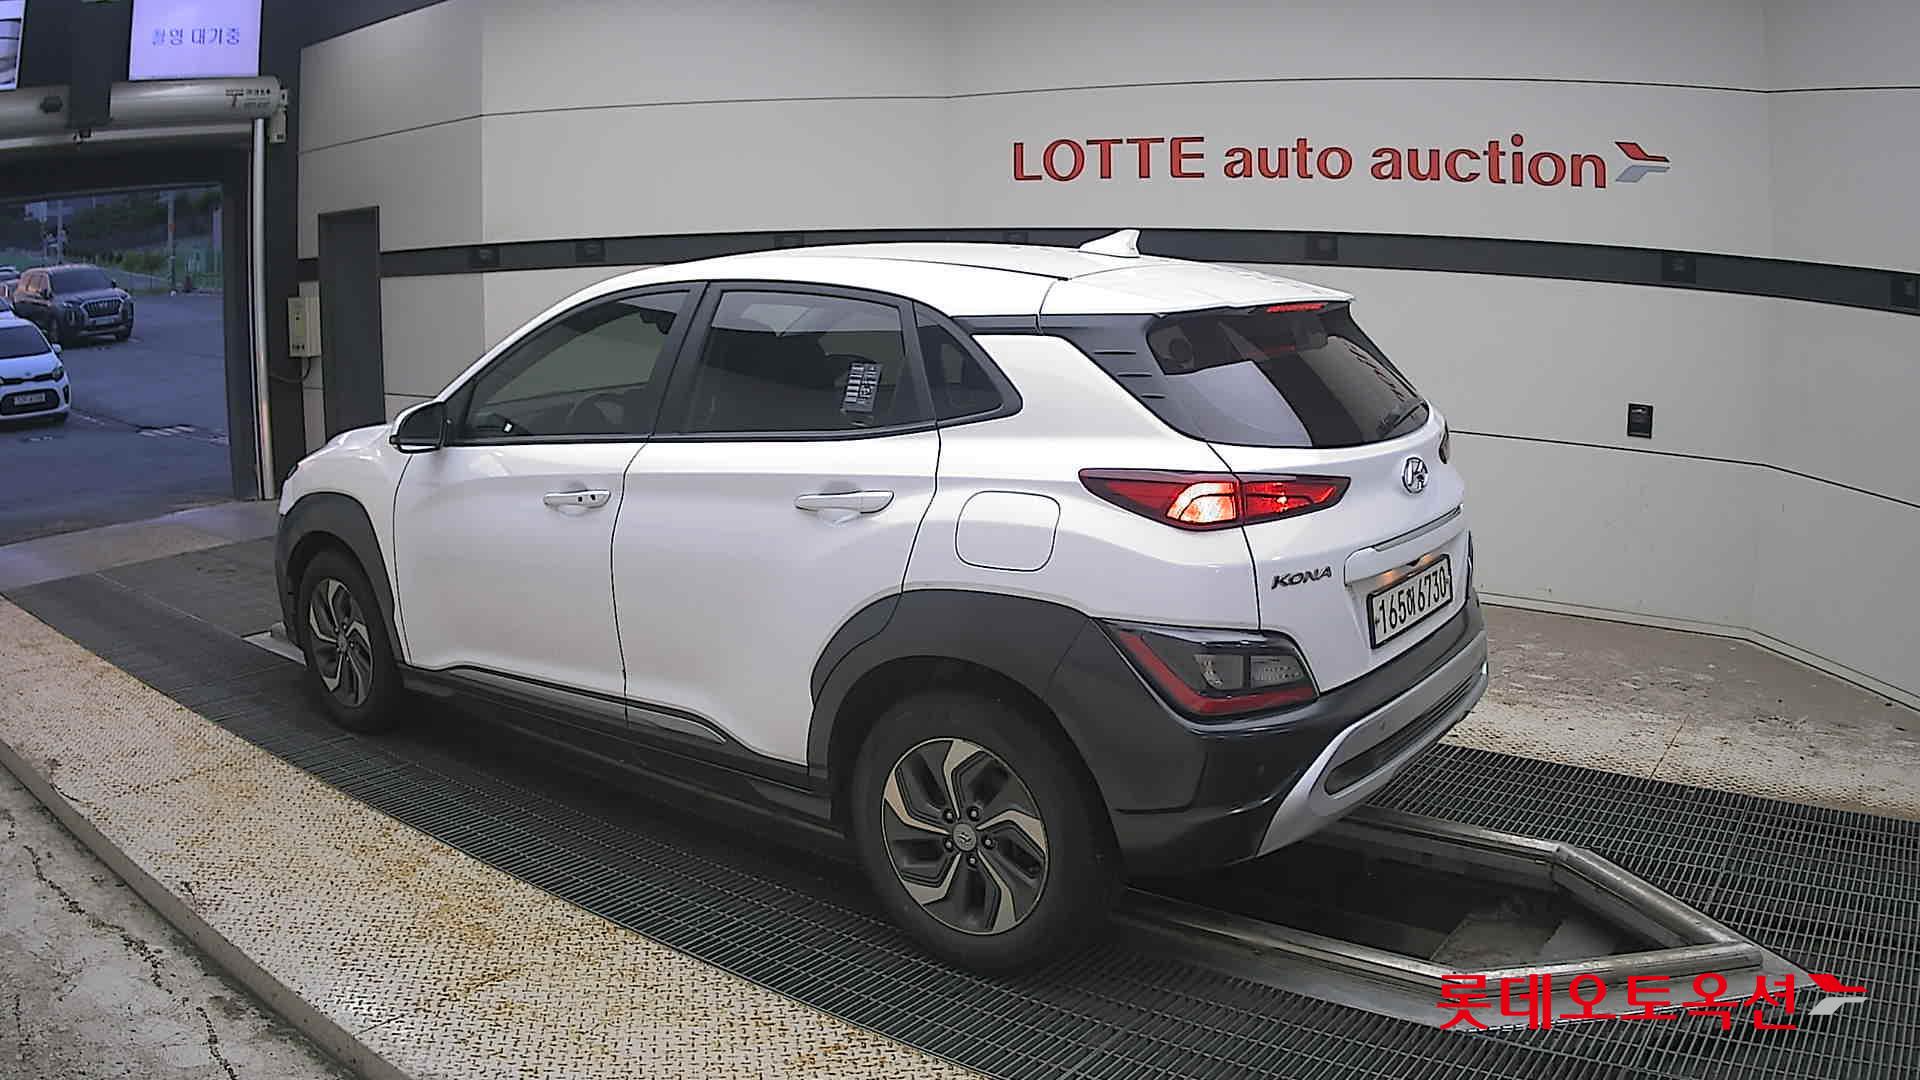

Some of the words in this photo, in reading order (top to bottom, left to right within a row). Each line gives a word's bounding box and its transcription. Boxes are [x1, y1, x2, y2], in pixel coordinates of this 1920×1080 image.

[192, 27, 240, 46] 대기중
[1013, 136, 1205, 182] LOTTE
[1223, 137, 1354, 180] auto
[1369, 134, 1607, 188] auction
[1271, 566, 1332, 590] KONA
